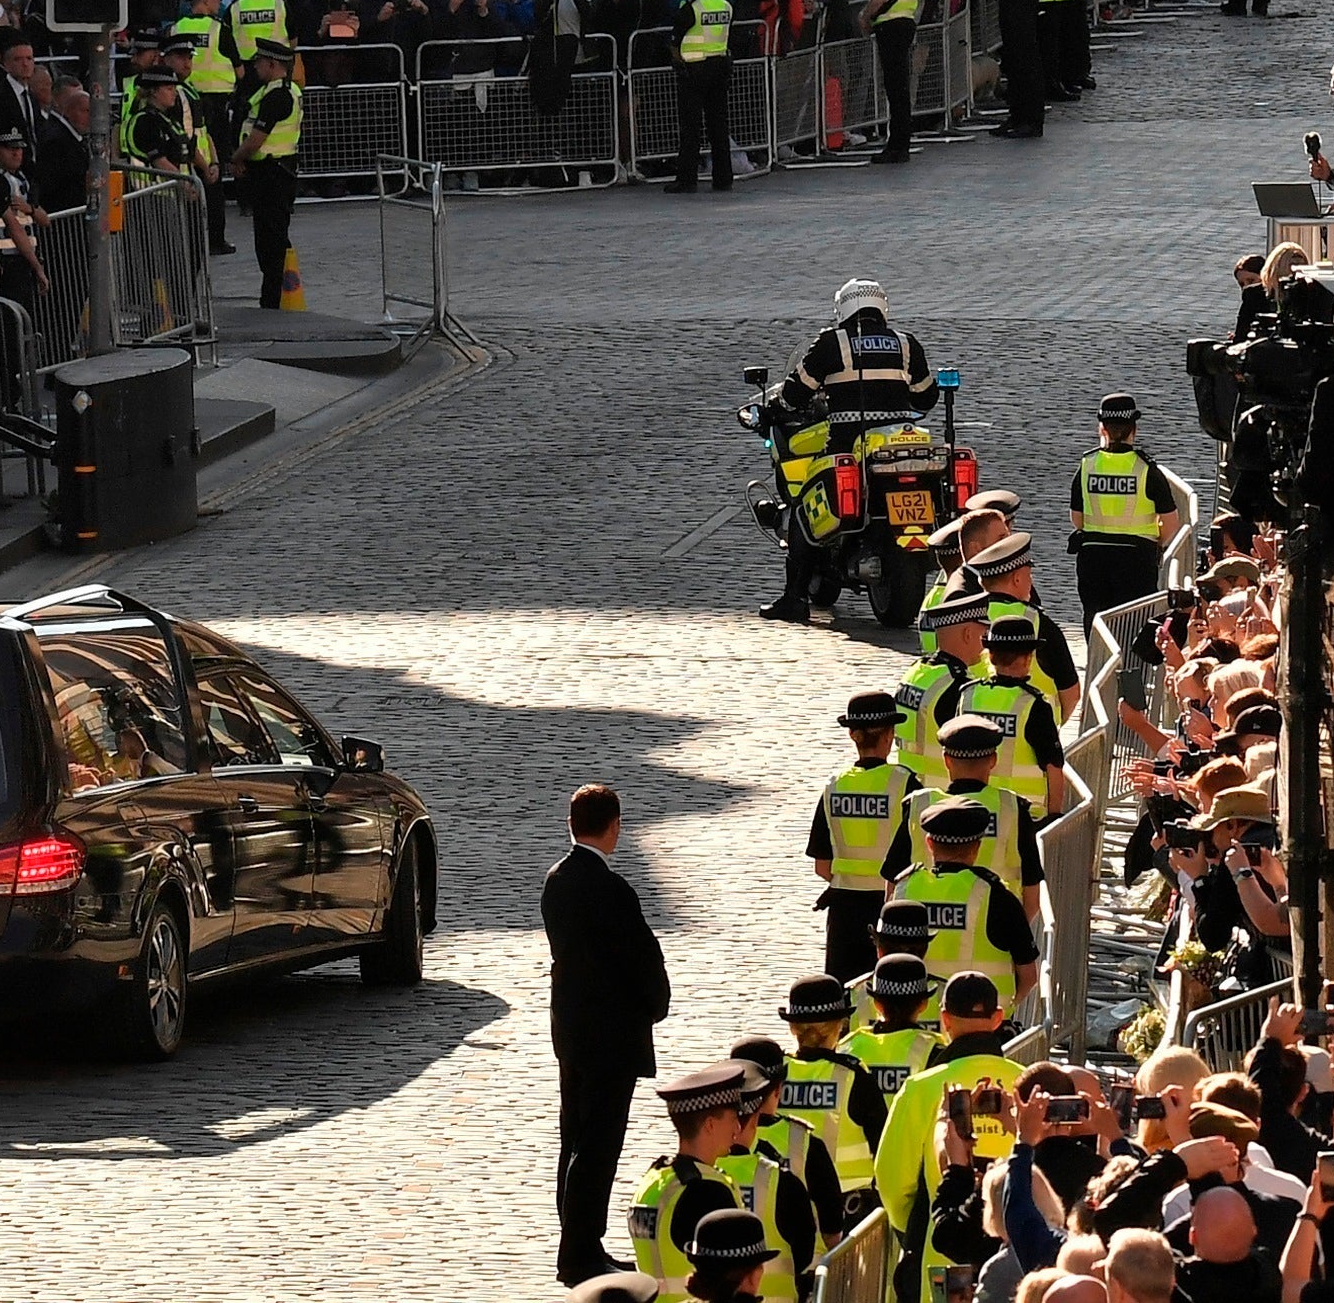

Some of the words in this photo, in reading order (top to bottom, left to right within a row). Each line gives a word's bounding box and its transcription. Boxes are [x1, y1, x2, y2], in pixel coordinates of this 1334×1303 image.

[240, 11, 275, 24] POLICE
[702, 12, 731, 24] POLICE
[854, 337, 898, 352] POLICE
[890, 436, 928, 444] POLICE
[1089, 476, 1135, 493] POLICE
[892, 493, 927, 508] LG21
[896, 508, 928, 521] VNZ
[832, 797, 886, 816] POLICE
[927, 906, 964, 928] LICE
[877, 1068, 908, 1091] ICE
[780, 1084, 835, 1106] OLICE
